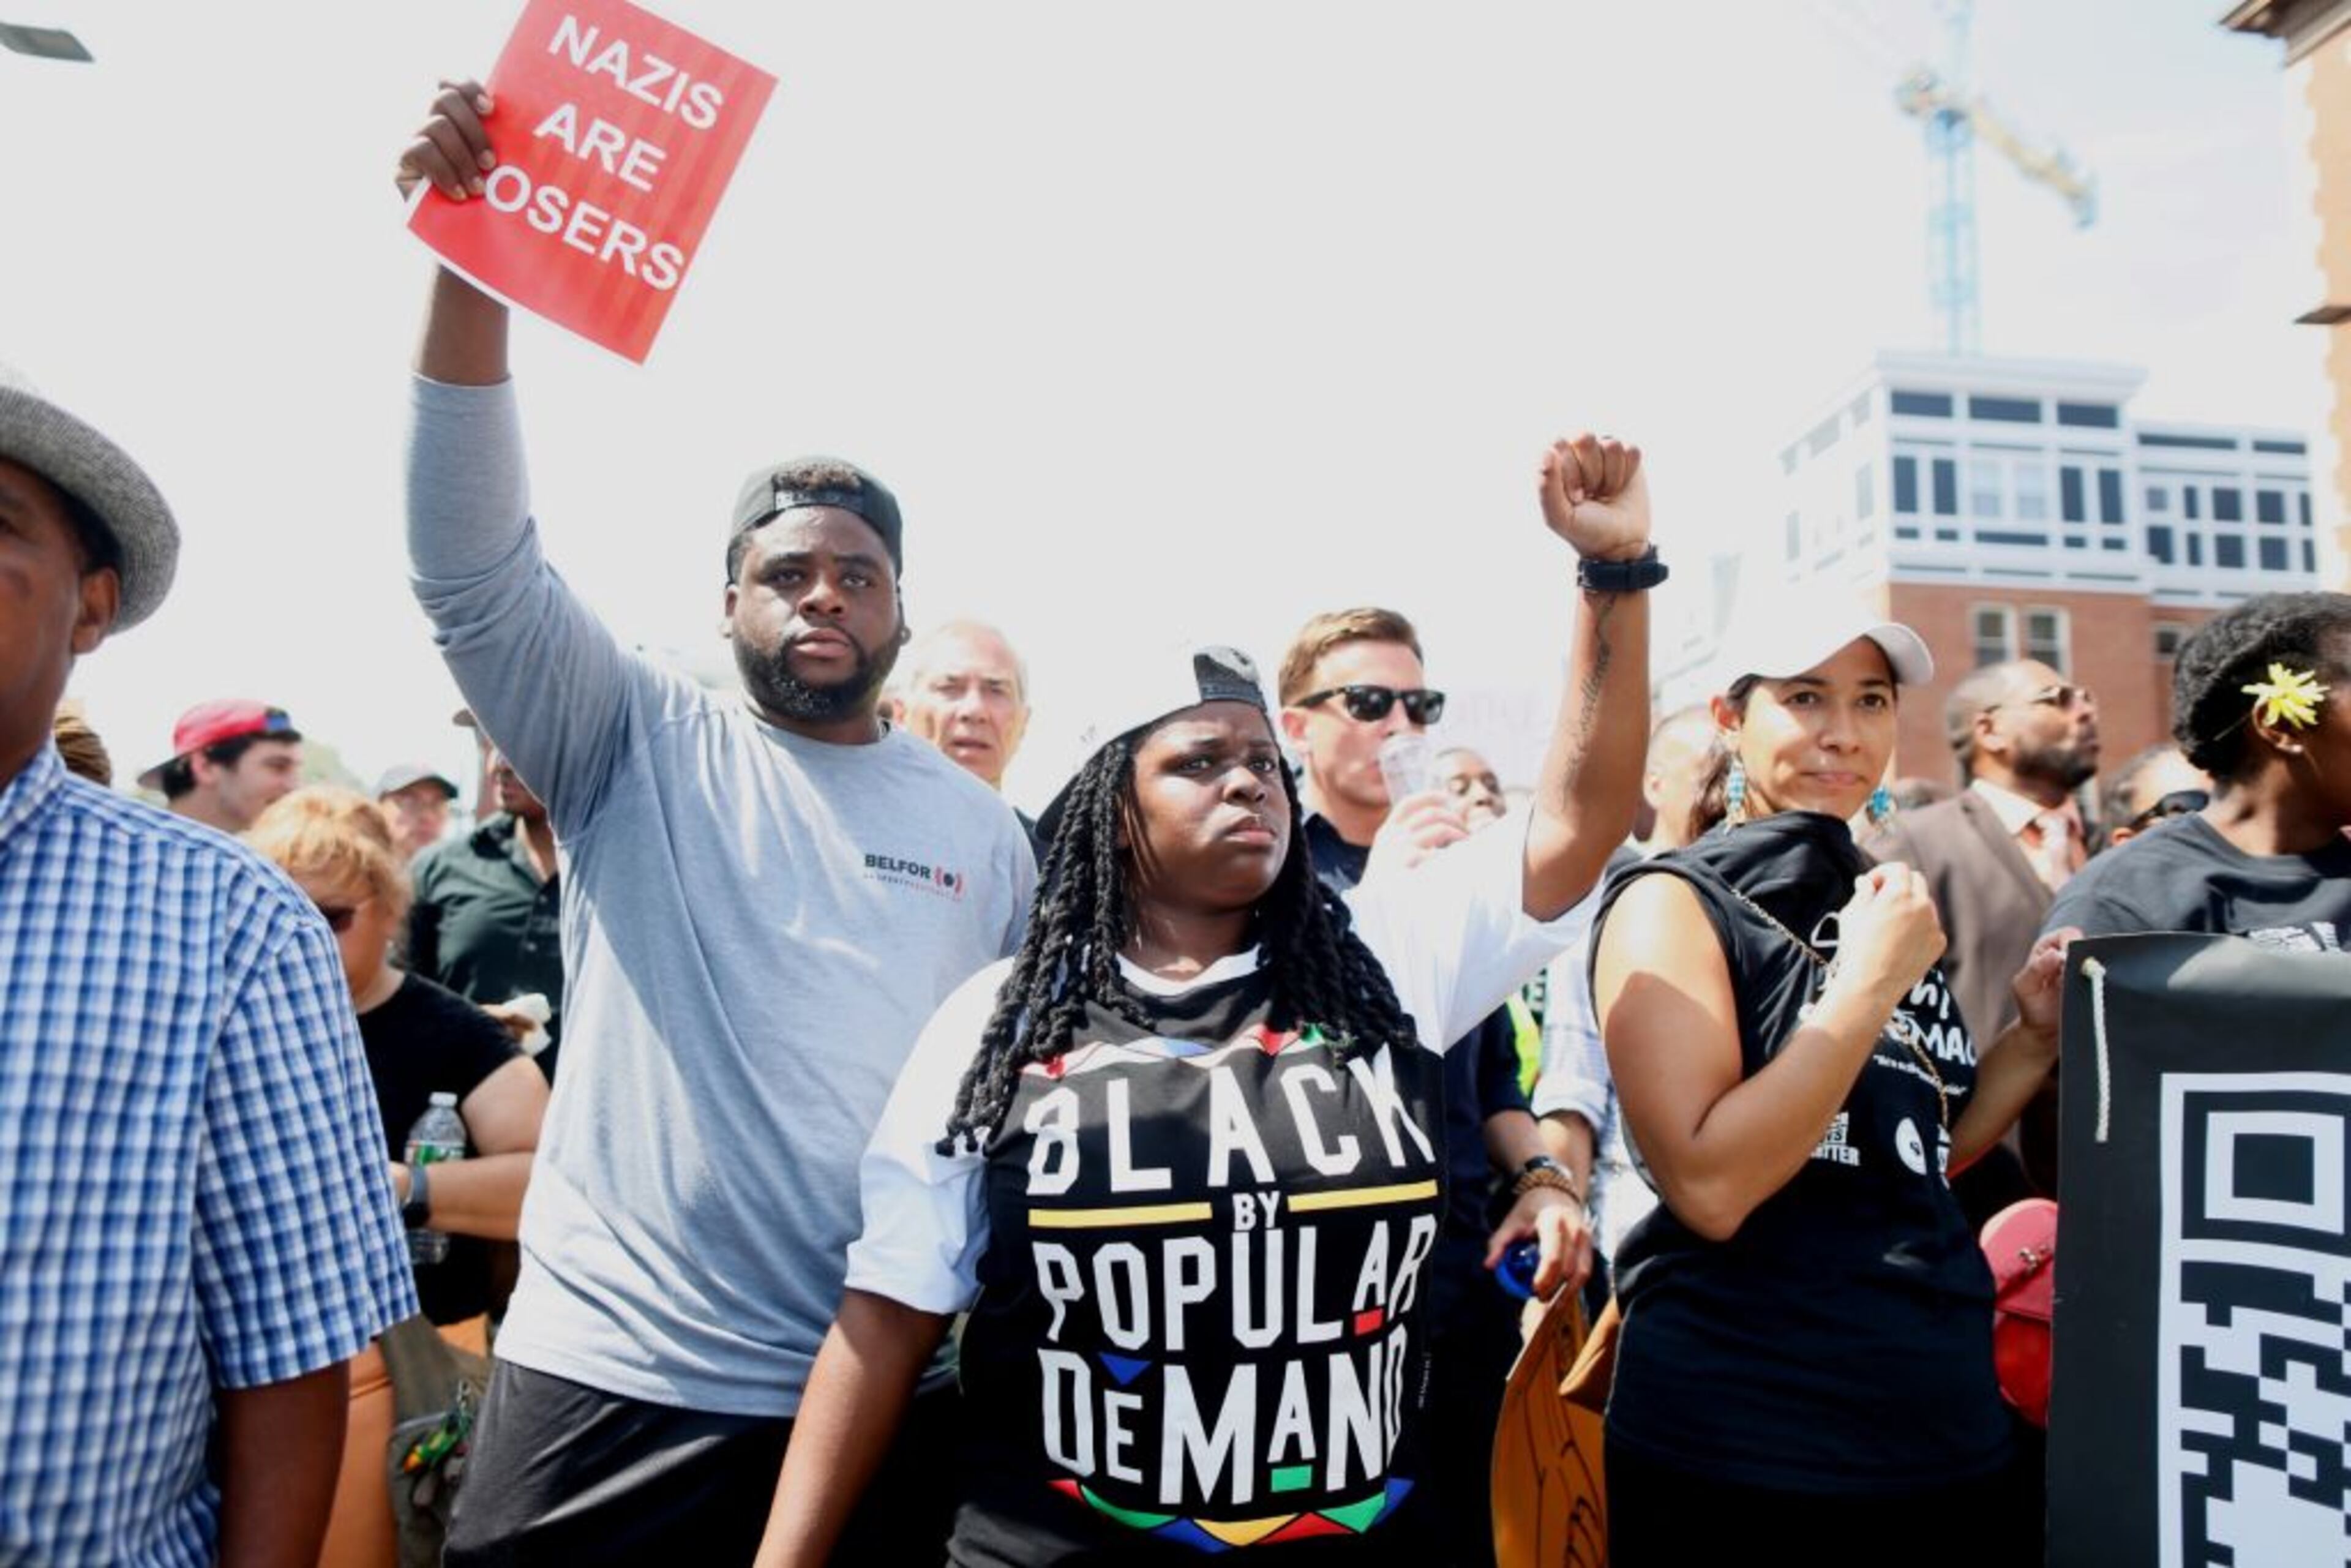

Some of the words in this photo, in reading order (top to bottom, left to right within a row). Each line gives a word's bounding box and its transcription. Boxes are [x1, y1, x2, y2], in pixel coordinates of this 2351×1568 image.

[548, 14, 724, 130] NAZIS
[533, 102, 667, 193] ARE
[485, 164, 685, 291] OSERS
[864, 854, 931, 879] BELFOR
[1026, 1043, 1436, 1195] BLACK
[1811, 1144, 1861, 1166] TTER
[1232, 1190, 1281, 1231] BY
[1032, 1214, 1438, 1351] POPULAR
[1037, 1323, 1407, 1505] DEMAND
